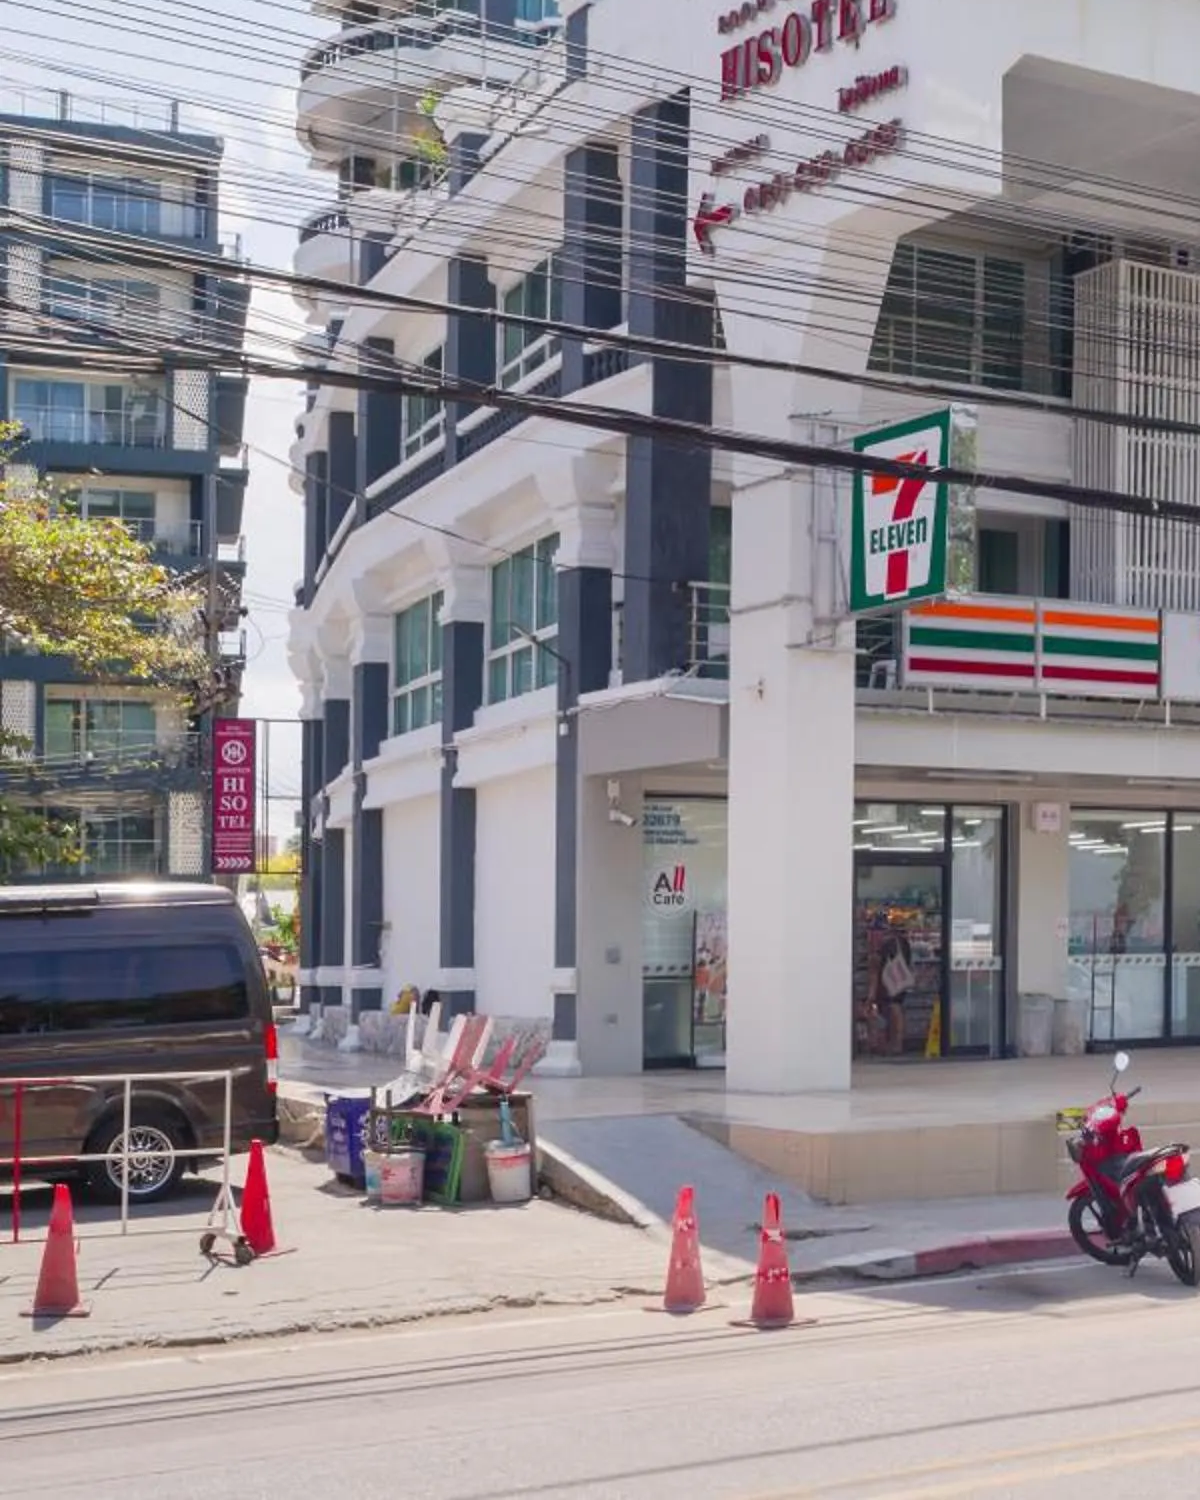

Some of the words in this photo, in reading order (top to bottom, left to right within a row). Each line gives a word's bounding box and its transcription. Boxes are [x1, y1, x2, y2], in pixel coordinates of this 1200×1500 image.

[872, 450, 928, 597] 7
[223, 777, 245, 792] HI
[220, 795, 248, 811] SO
[217, 815, 250, 829] TEL
[654, 865, 685, 893] All
